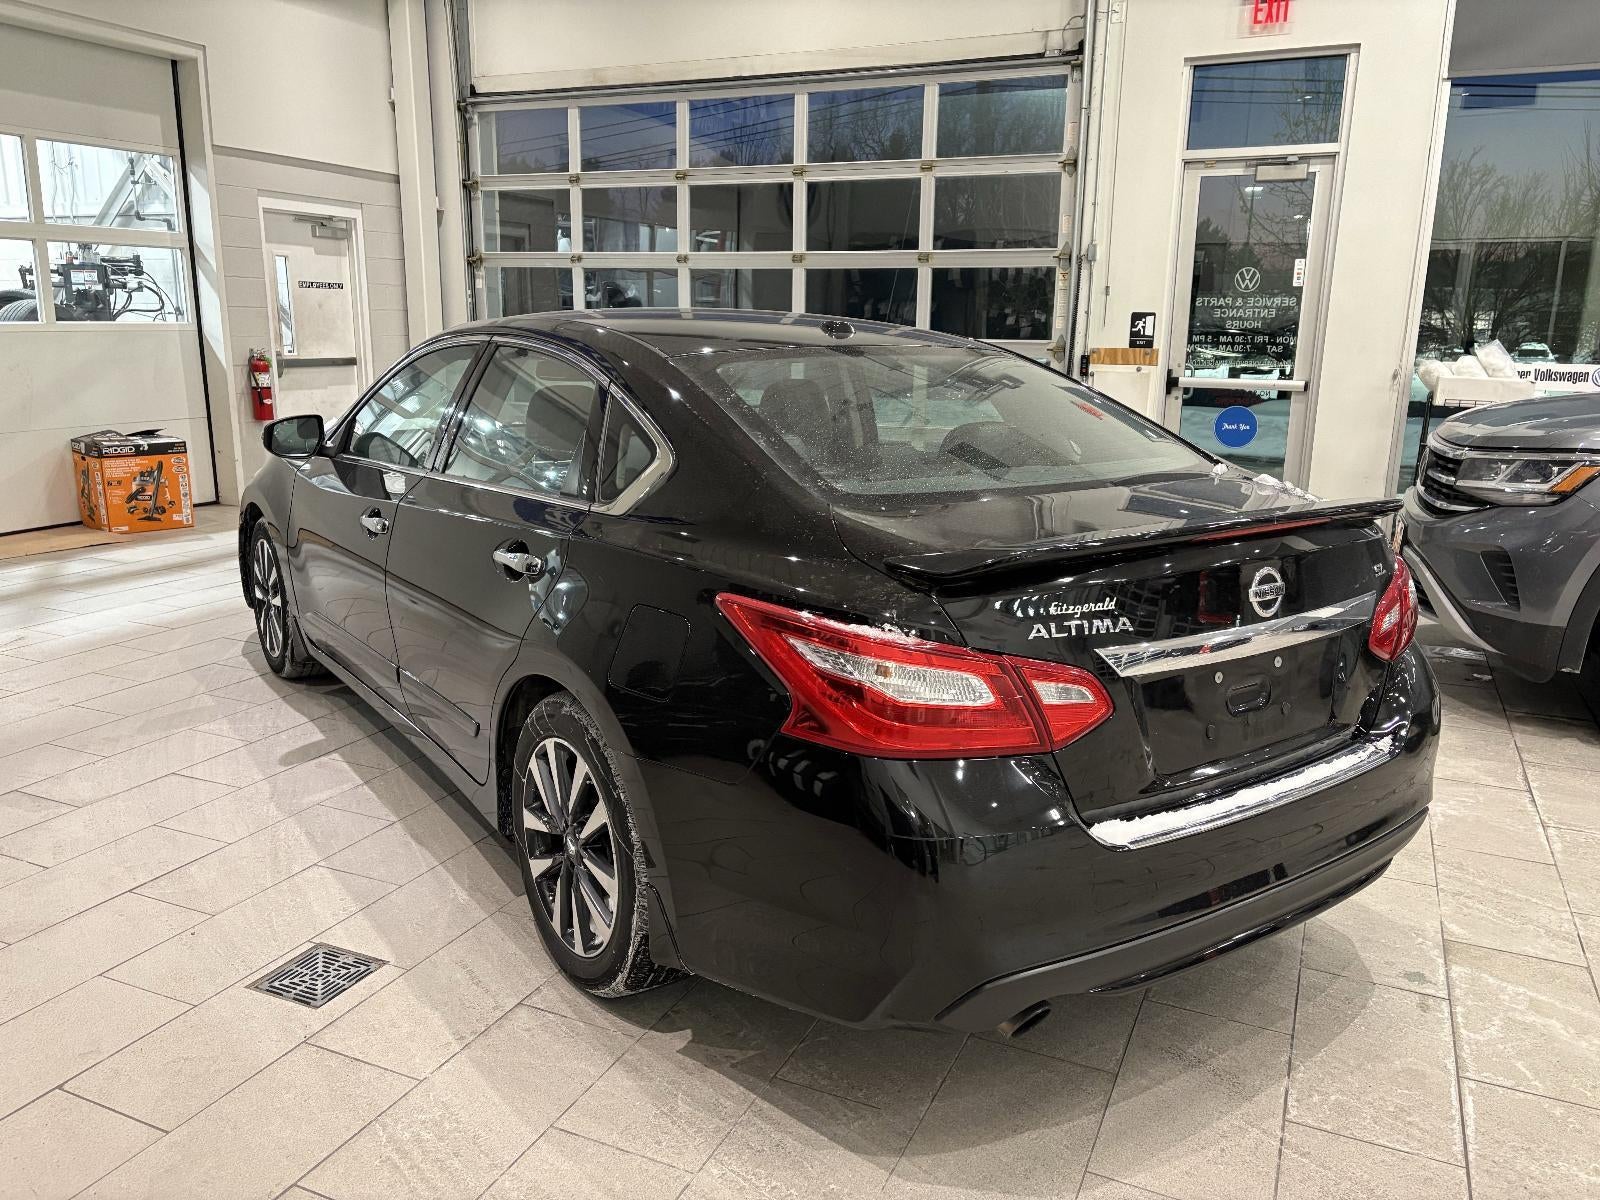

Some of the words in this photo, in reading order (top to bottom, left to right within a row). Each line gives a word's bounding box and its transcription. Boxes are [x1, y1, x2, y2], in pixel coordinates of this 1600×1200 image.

[1253, 0, 1290, 24] EXIT
[298, 281, 329, 289] EMPLOYEES
[329, 282, 344, 290] ONLY
[1534, 368, 1590, 384] Volkswagen
[103, 446, 135, 455] RIDGID
[1048, 597, 1117, 618] Fitzgerald
[1027, 617, 1134, 640] ALTIMA
